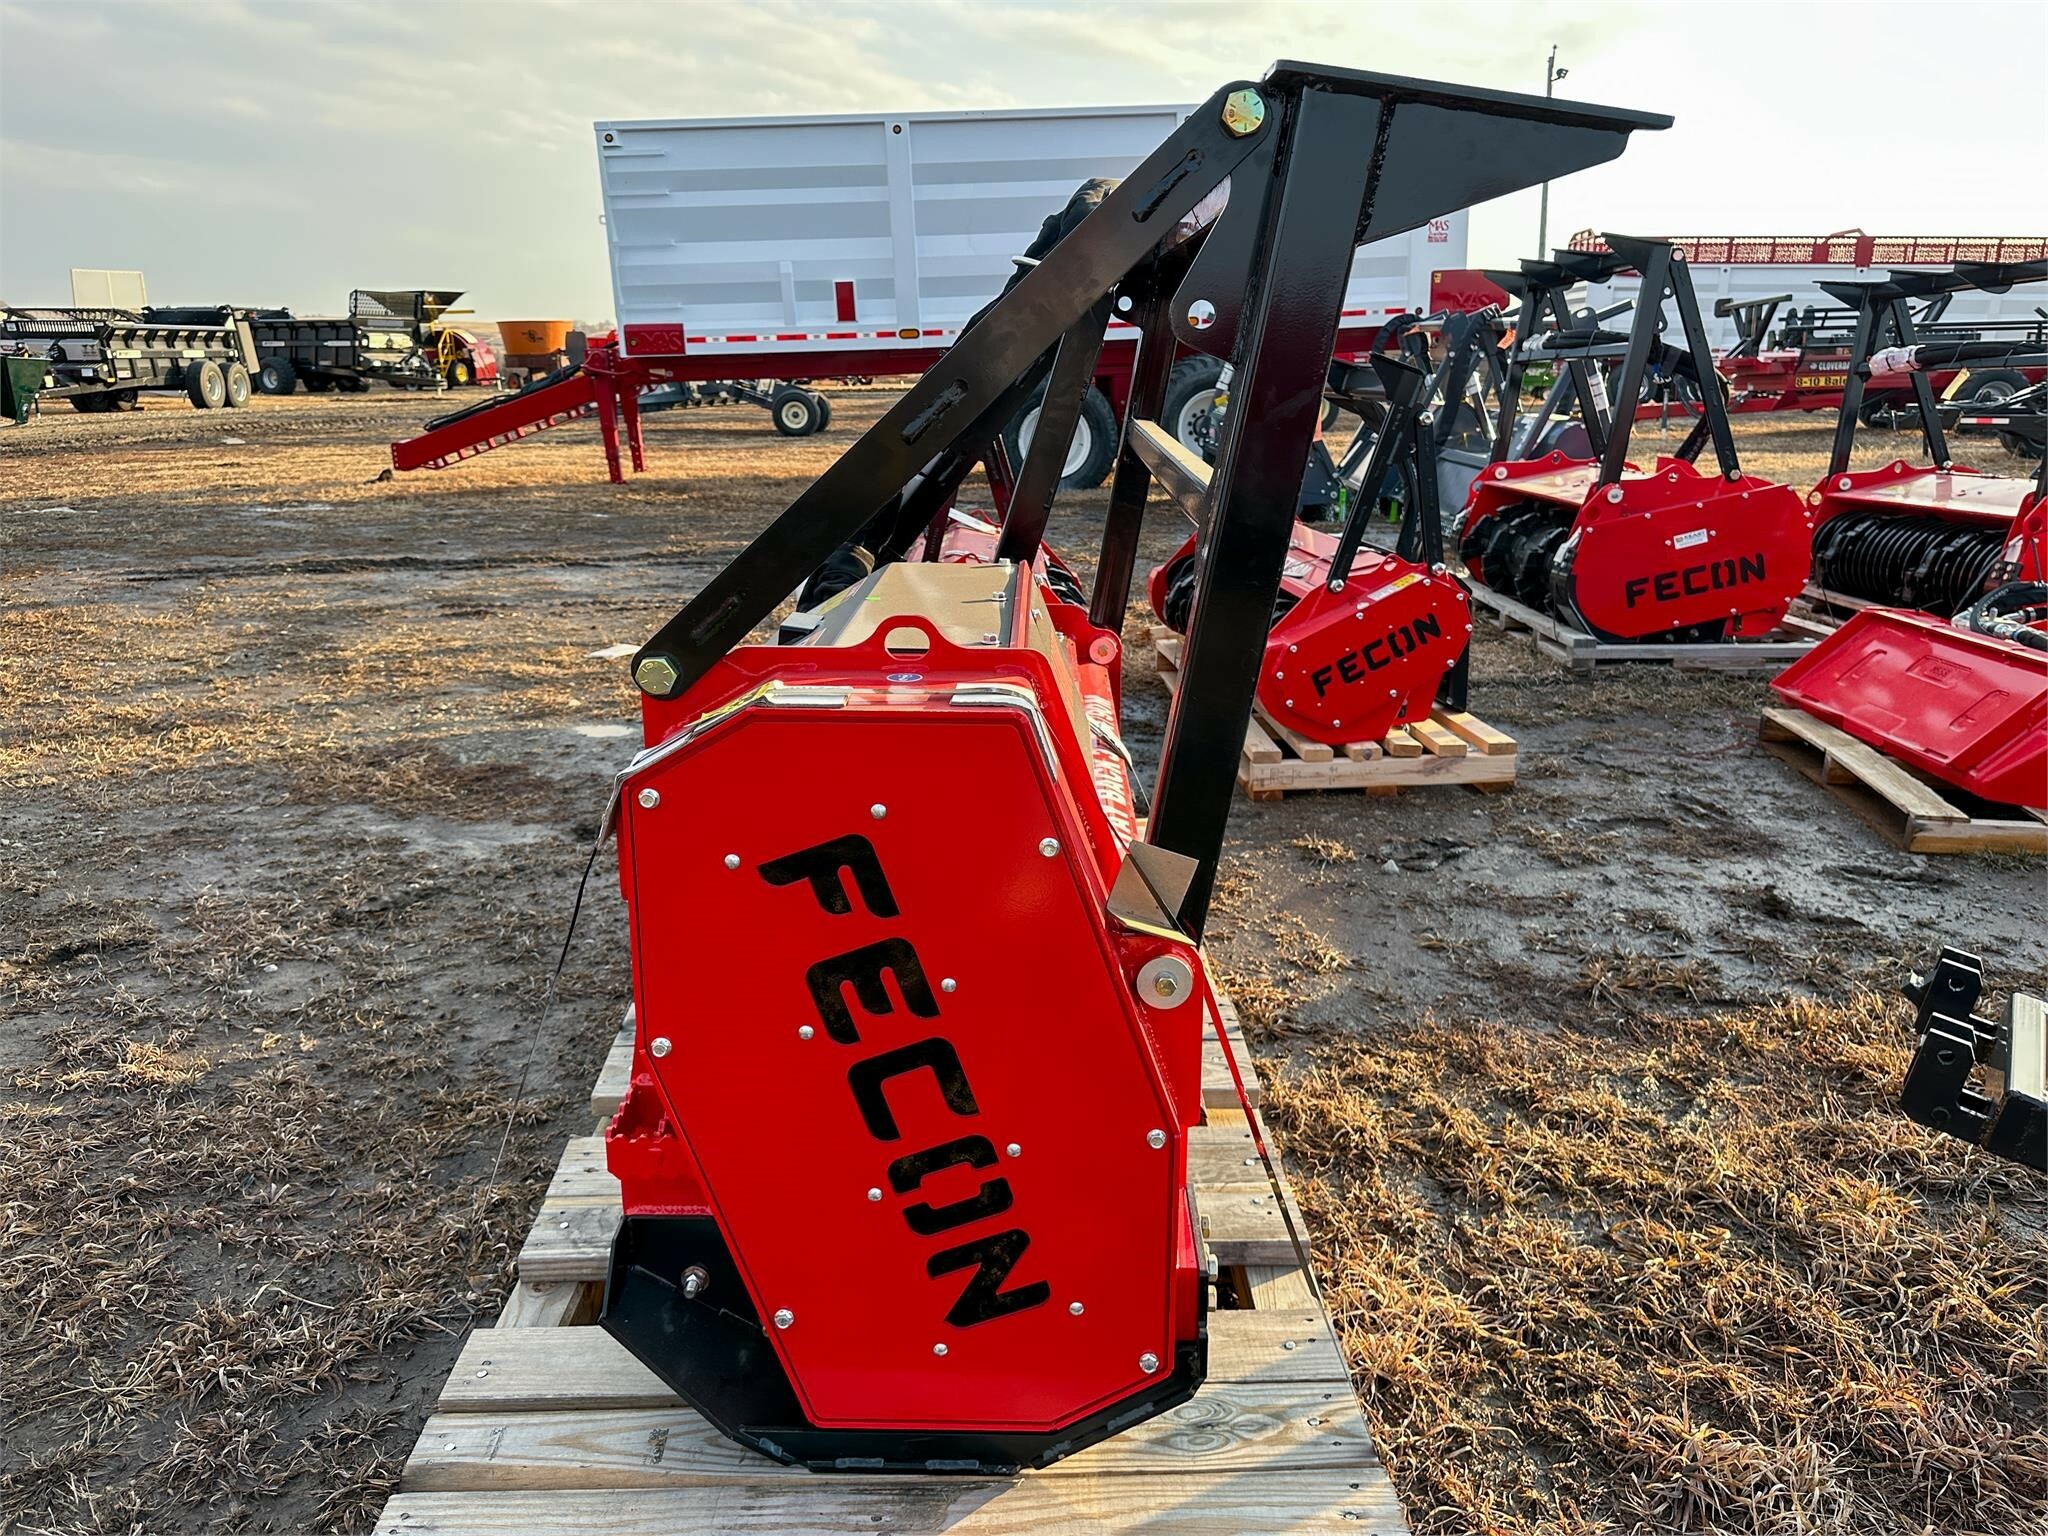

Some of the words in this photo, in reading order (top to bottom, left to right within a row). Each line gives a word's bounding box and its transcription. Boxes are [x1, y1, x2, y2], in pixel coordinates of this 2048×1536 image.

[1429, 220, 1449, 232] MAS
[1625, 553, 1766, 608] FECON
[1311, 613, 1442, 699] FECON
[1092, 757, 1127, 805] BACK
[757, 834, 1051, 1328] FECON
